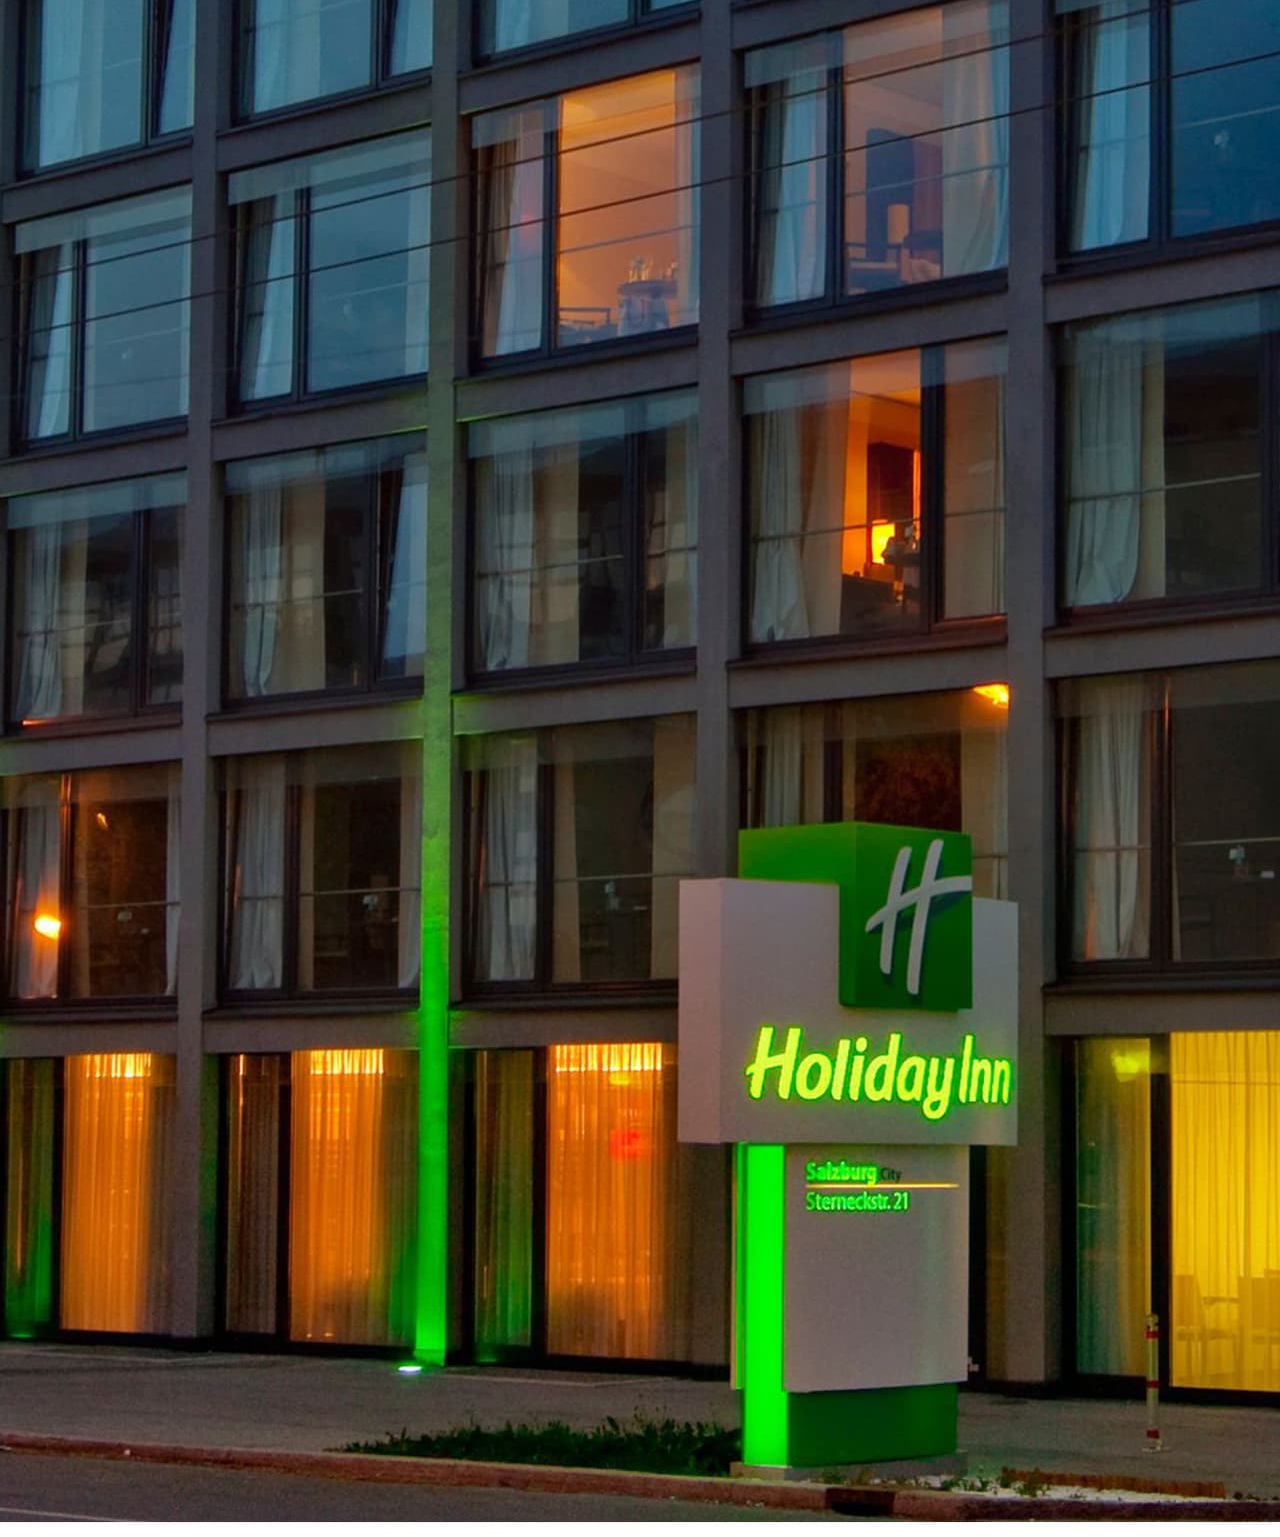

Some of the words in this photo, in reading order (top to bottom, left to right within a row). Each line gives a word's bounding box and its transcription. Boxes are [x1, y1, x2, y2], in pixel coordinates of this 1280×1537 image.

[865, 838, 973, 996] H
[805, 1161, 877, 1186] Salzburg
[880, 1168, 902, 1183] City
[805, 1191, 891, 1211] Sterneckstr.
[893, 1191, 909, 1211] 21
